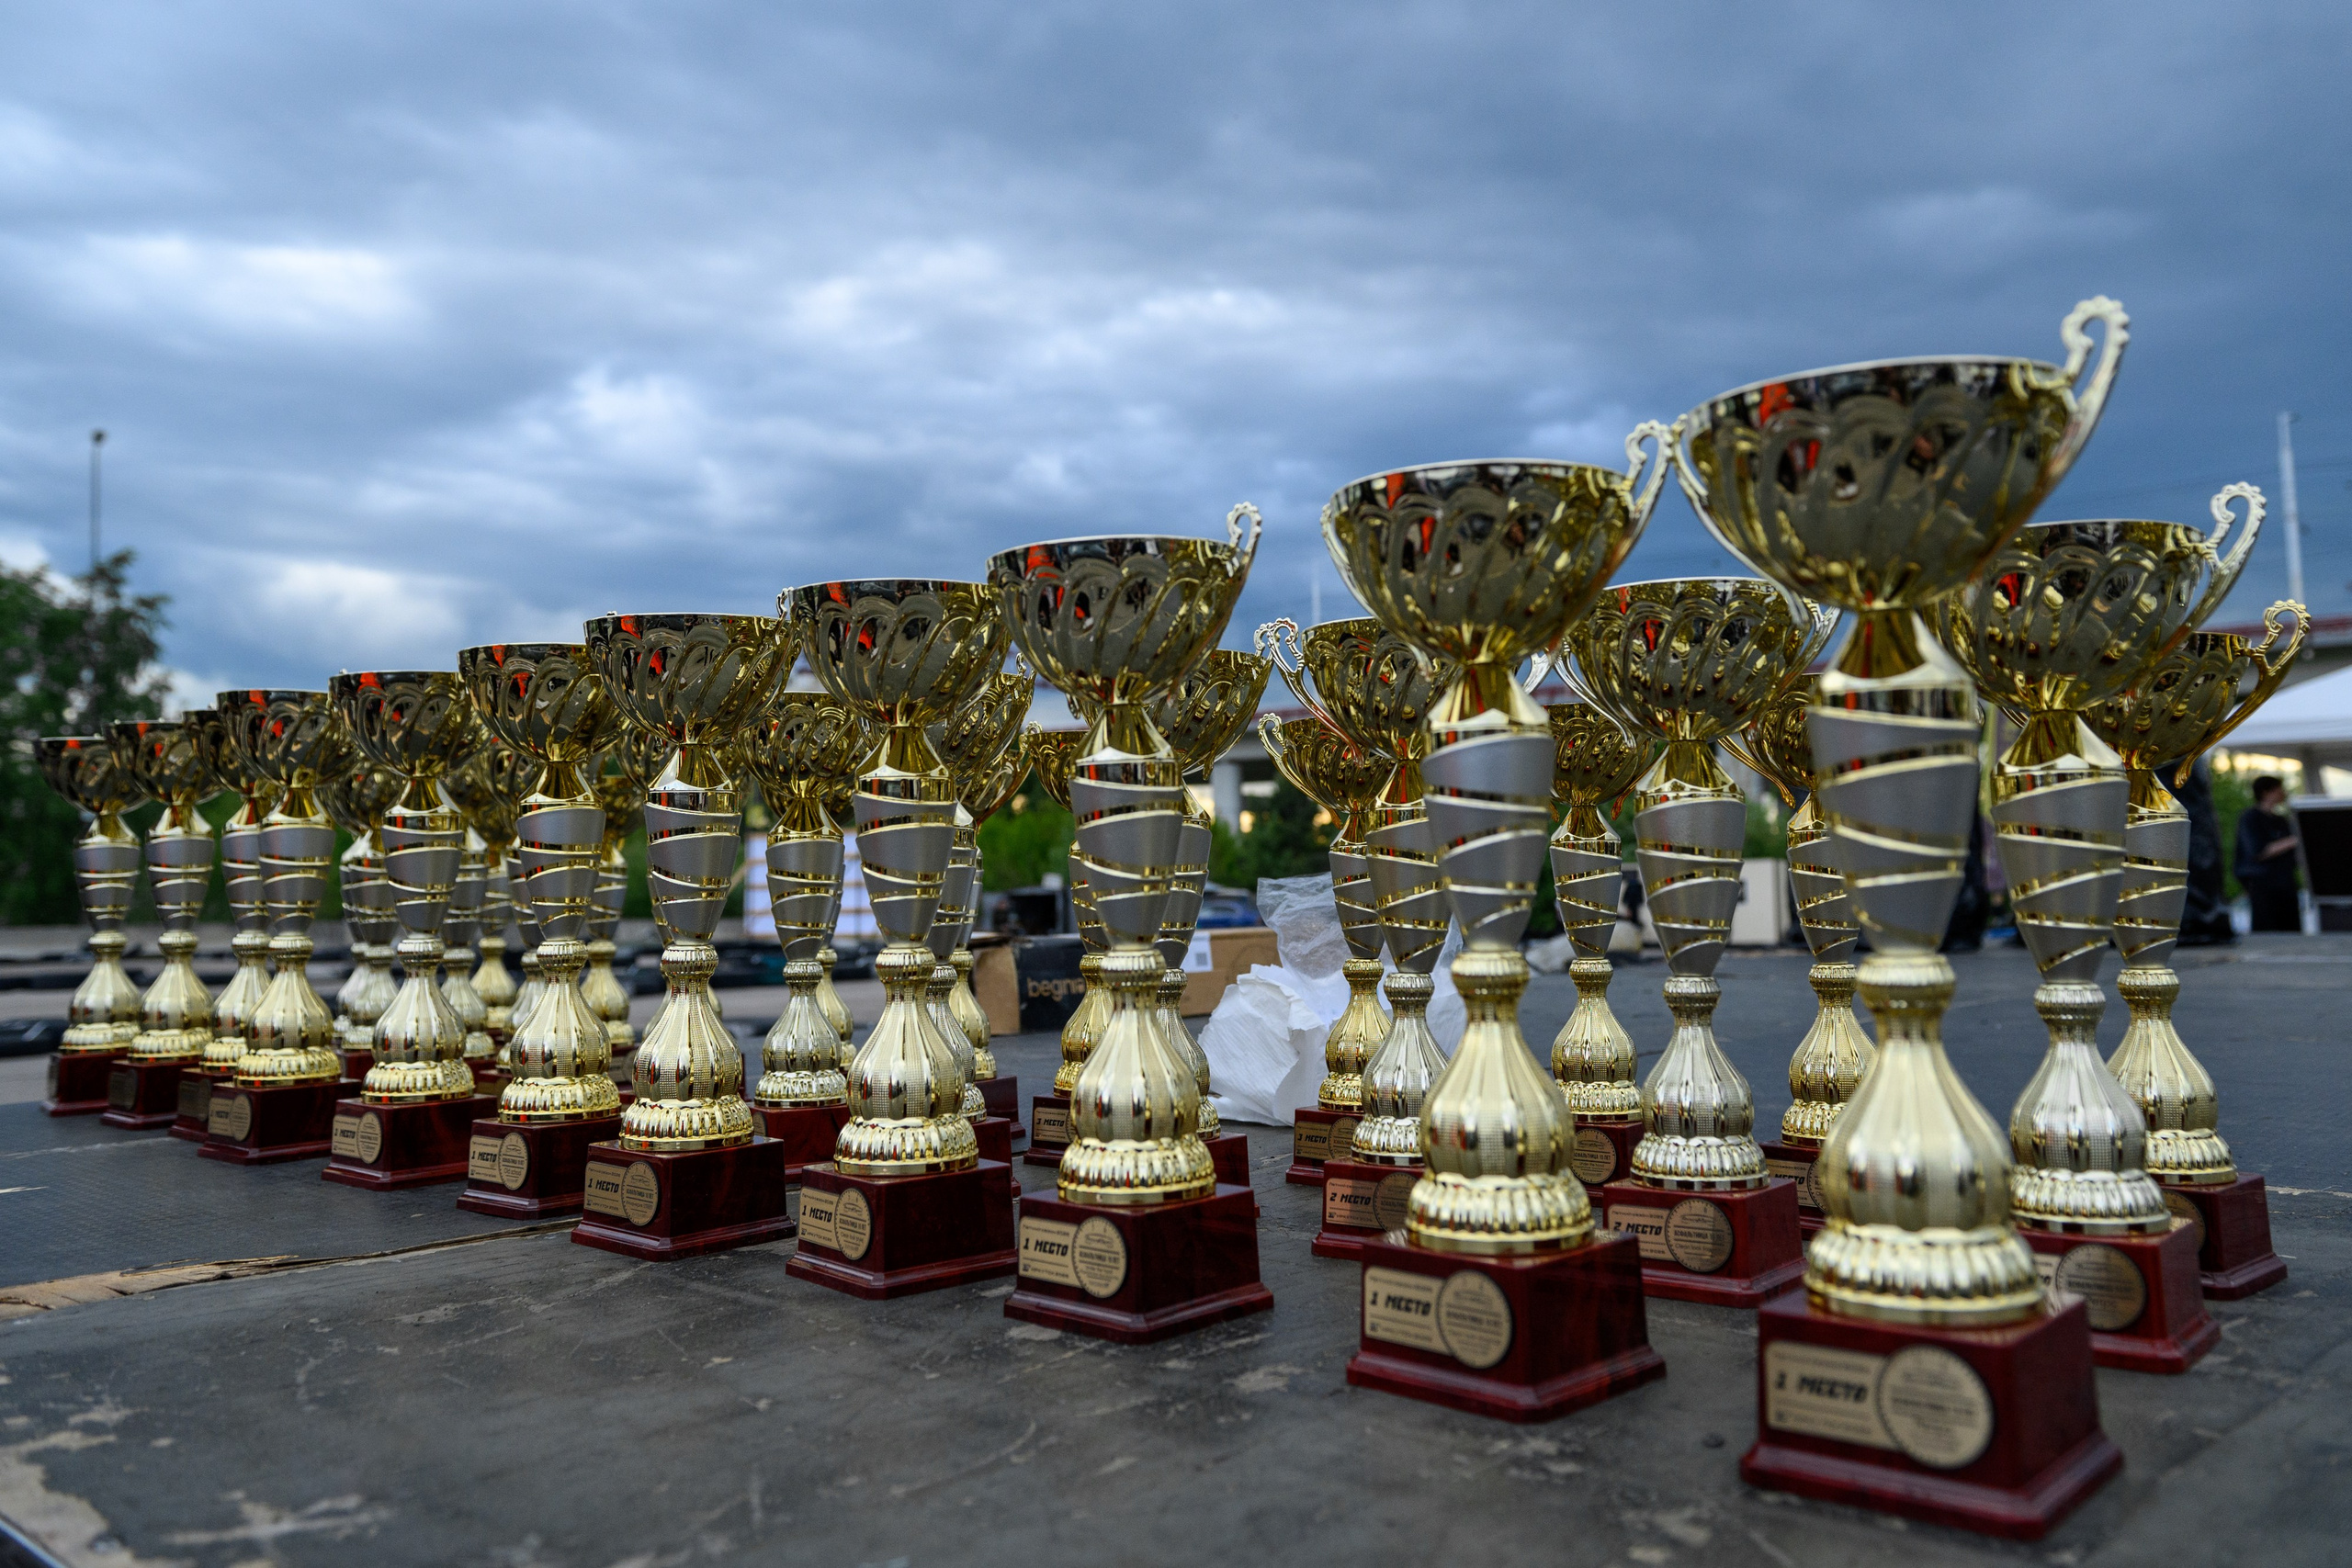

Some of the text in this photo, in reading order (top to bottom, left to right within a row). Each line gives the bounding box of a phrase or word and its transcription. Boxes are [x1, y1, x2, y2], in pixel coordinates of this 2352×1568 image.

[1044, 1119, 1065, 1127] МЕСТО
[1305, 1134, 1328, 1144] МЕСТО
[471, 1150, 476, 1159] 1
[478, 1151, 497, 1163] МЕСТО
[587, 1178, 620, 1193] 1 МЕСТО
[1329, 1192, 1337, 1201] 2
[1340, 1194, 1372, 1205] МЕСТО
[801, 1204, 832, 1223] 1 МЕСТО
[1613, 1222, 1663, 1235] 2 МЕСТО
[1023, 1237, 1069, 1257] 1 МЕСТО
[1370, 1292, 1431, 1317] 1 МЕСТО
